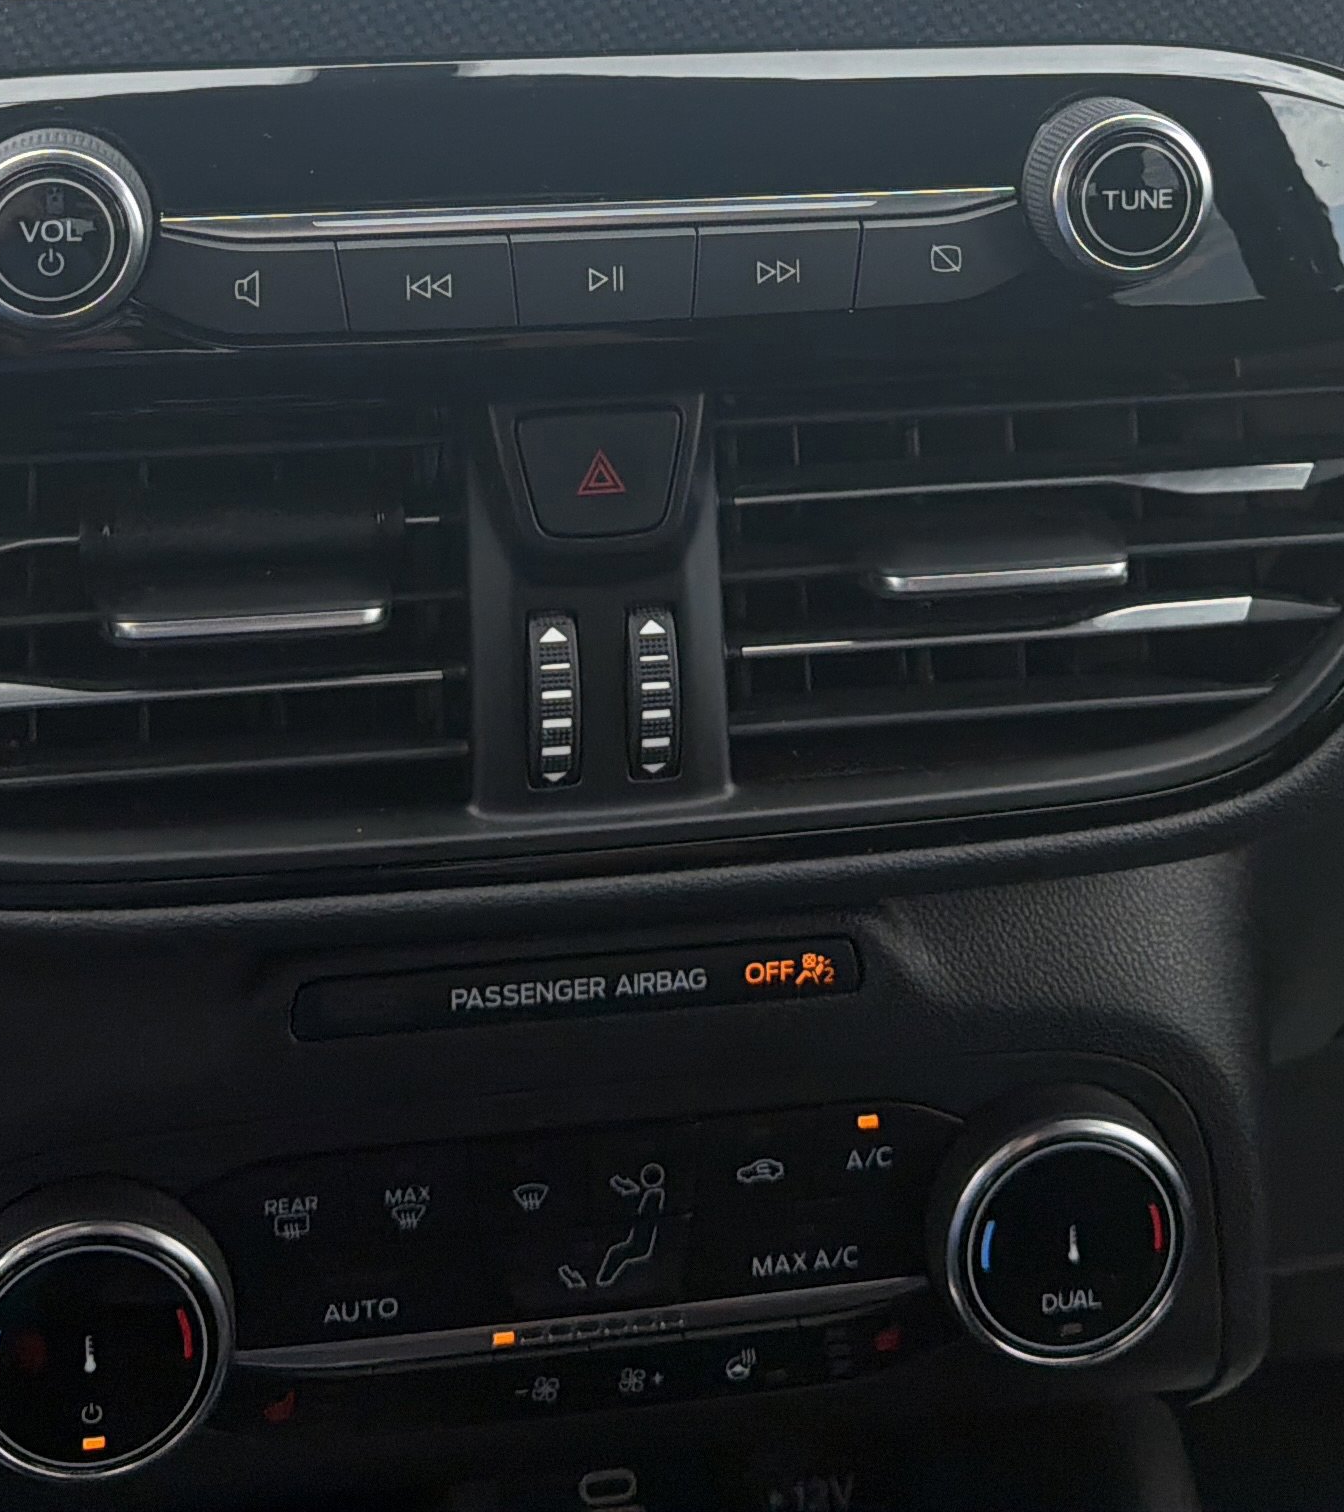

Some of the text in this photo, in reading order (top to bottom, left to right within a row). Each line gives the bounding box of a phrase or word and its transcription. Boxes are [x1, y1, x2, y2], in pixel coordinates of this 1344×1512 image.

[1102, 189, 1173, 210] TUNE
[19, 220, 82, 243] VOL
[450, 977, 607, 1012] PASSENGER
[614, 967, 708, 998] AIRBAG
[745, 960, 795, 985] OFF
[846, 1146, 893, 1170] A/C
[263, 1196, 318, 1217] REAR
[383, 1186, 432, 1206] MAX
[752, 1245, 859, 1277] MAX A/C
[322, 1297, 399, 1324] AUTO
[1040, 1289, 1102, 1313] DUAL
